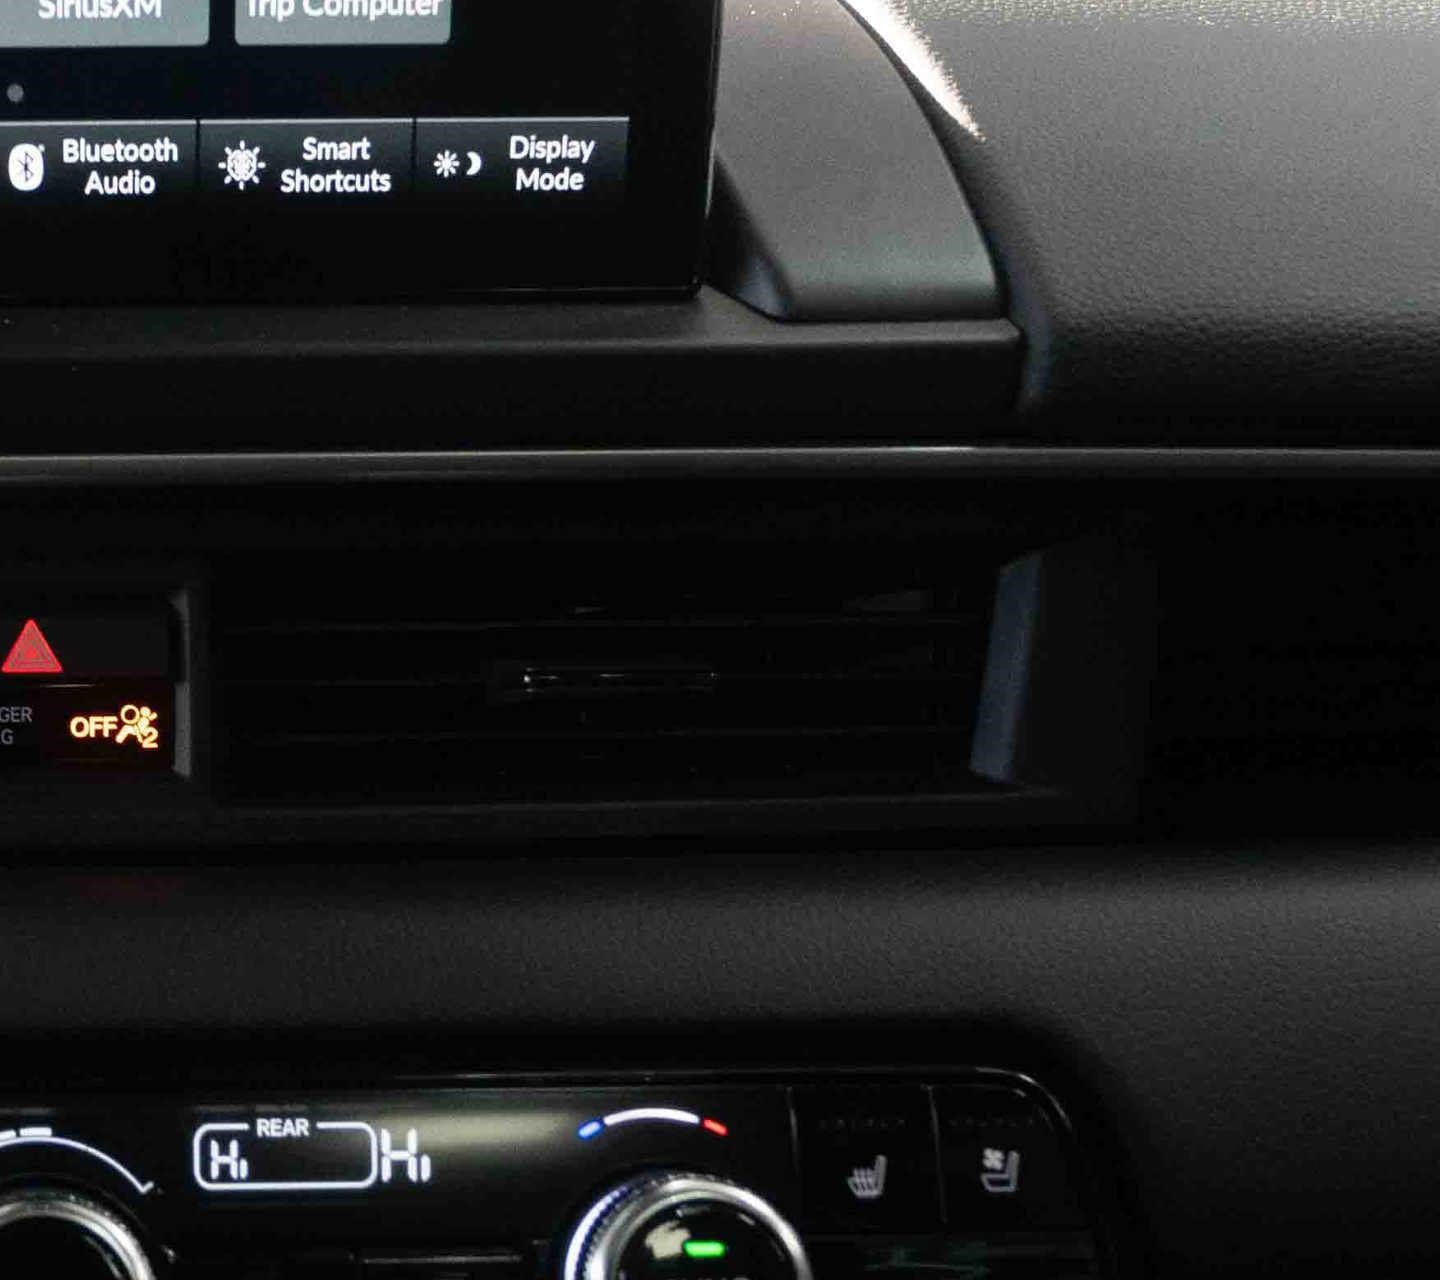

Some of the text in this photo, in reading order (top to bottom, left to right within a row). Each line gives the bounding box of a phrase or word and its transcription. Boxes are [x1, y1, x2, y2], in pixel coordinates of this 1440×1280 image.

[63, 139, 179, 163] Bluetooth
[302, 136, 370, 161] Smart
[509, 135, 594, 164] Display
[84, 170, 156, 195] Audio
[281, 168, 391, 194] Shortcuts
[516, 167, 584, 192] Mode
[70, 716, 118, 737] OFF
[257, 1119, 309, 1136] REAR
